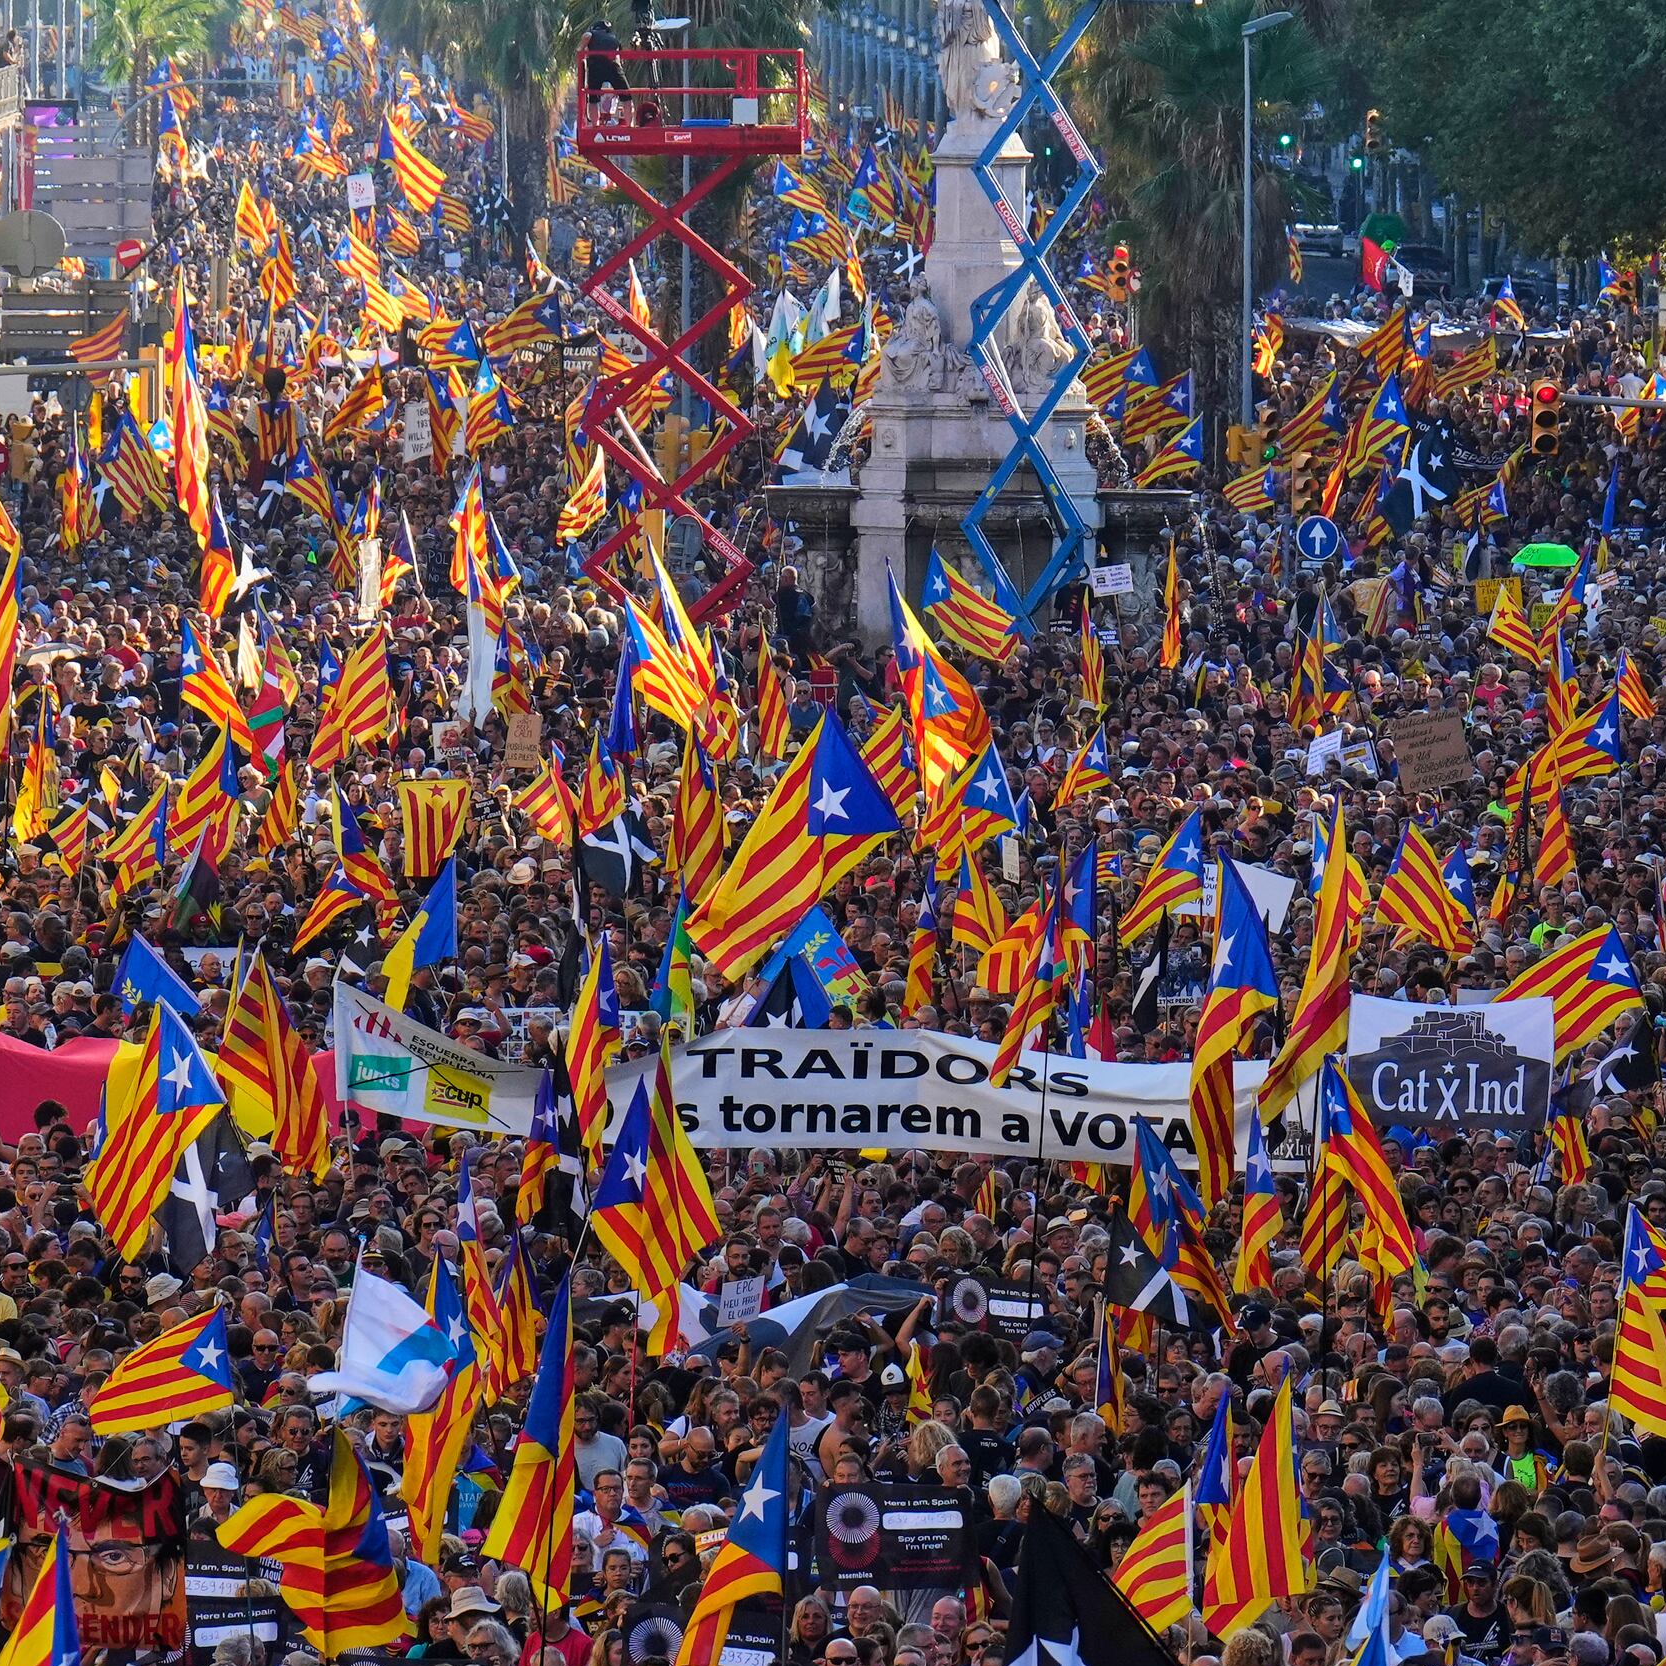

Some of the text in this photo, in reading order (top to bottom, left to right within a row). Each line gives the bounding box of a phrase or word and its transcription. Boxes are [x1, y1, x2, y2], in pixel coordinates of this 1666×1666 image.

[409, 1043, 496, 1082] REPUBLICANA
[411, 1034, 477, 1068] ESQUERRA
[356, 1061, 401, 1090] junts
[720, 1097, 981, 1136] tornarem
[1001, 1112, 1030, 1143] a
[1025, 1388, 1057, 1415] BOTIFLERS
[14, 1461, 178, 1541] NEVER
[931, 1498, 959, 1507] Spain
[897, 1535, 915, 1543] Spy
[838, 1571, 873, 1579] assemblea
